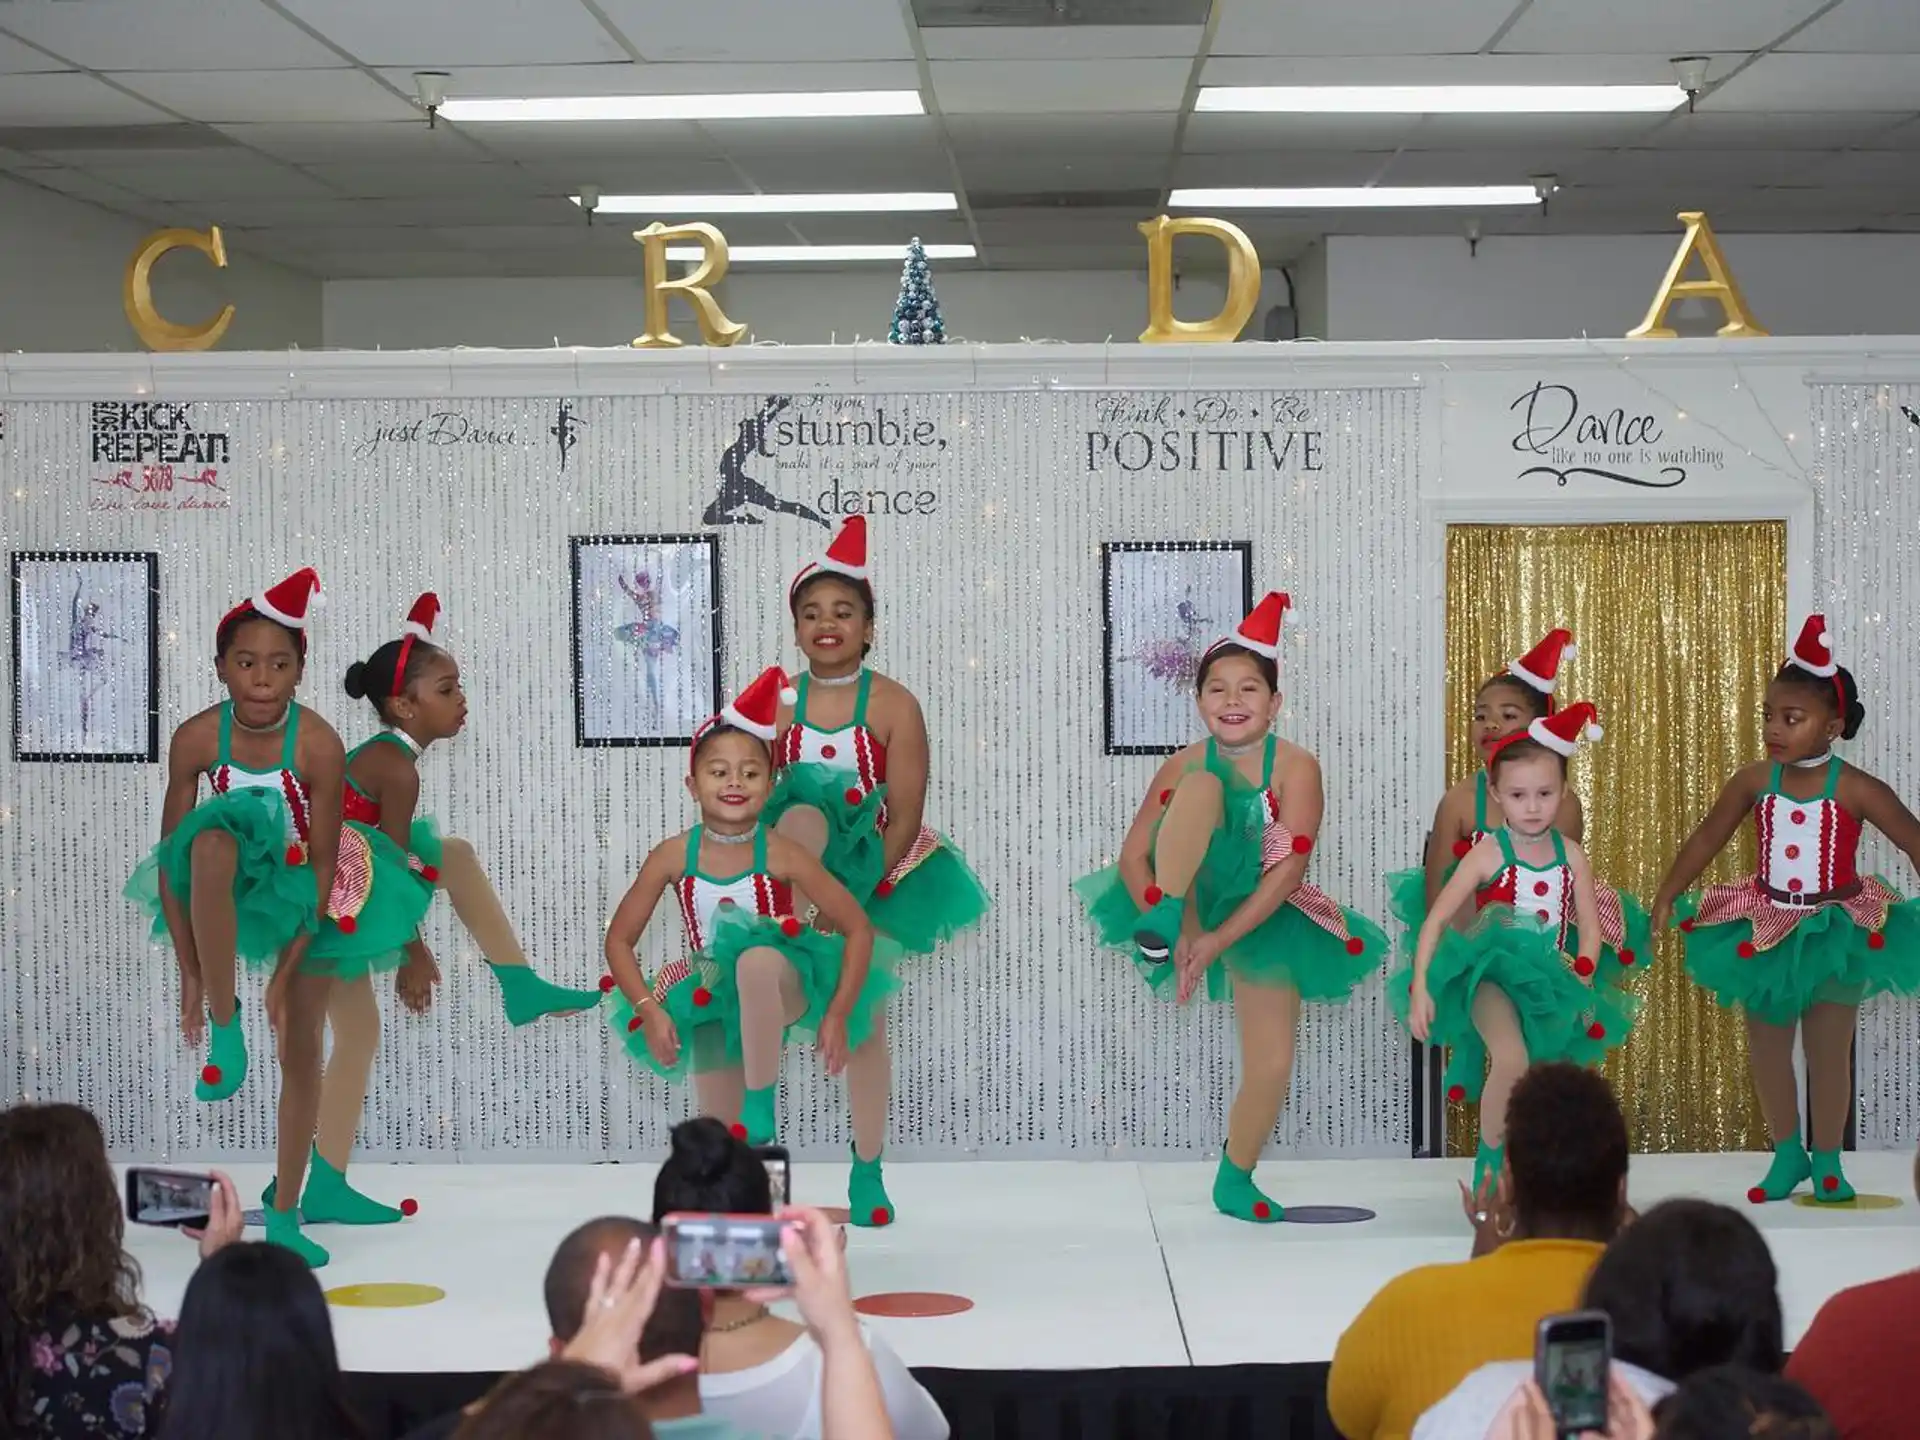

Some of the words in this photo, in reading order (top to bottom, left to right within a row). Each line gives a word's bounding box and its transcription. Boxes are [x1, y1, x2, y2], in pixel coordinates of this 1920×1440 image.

[122, 225, 236, 352] C
[632, 220, 749, 348] R
[1137, 214, 1261, 343] D
[1625, 210, 1771, 338] A
[777, 408, 947, 450] stumble,
[1095, 396, 1171, 428] Think
[1193, 397, 1238, 424] Do
[1271, 397, 1312, 424] Be
[1510, 380, 1664, 455] Dance
[92, 432, 230, 463] REPEAT!
[351, 419, 424, 460] just
[1086, 430, 1324, 472] POSITIVE
[1552, 446, 1577, 464] like
[1583, 450, 1602, 464] no
[1607, 450, 1634, 464] one
[1640, 448, 1652, 464] is
[1657, 446, 1724, 470] watching
[886, 450, 902, 474] of
[817, 478, 937, 515] dance
